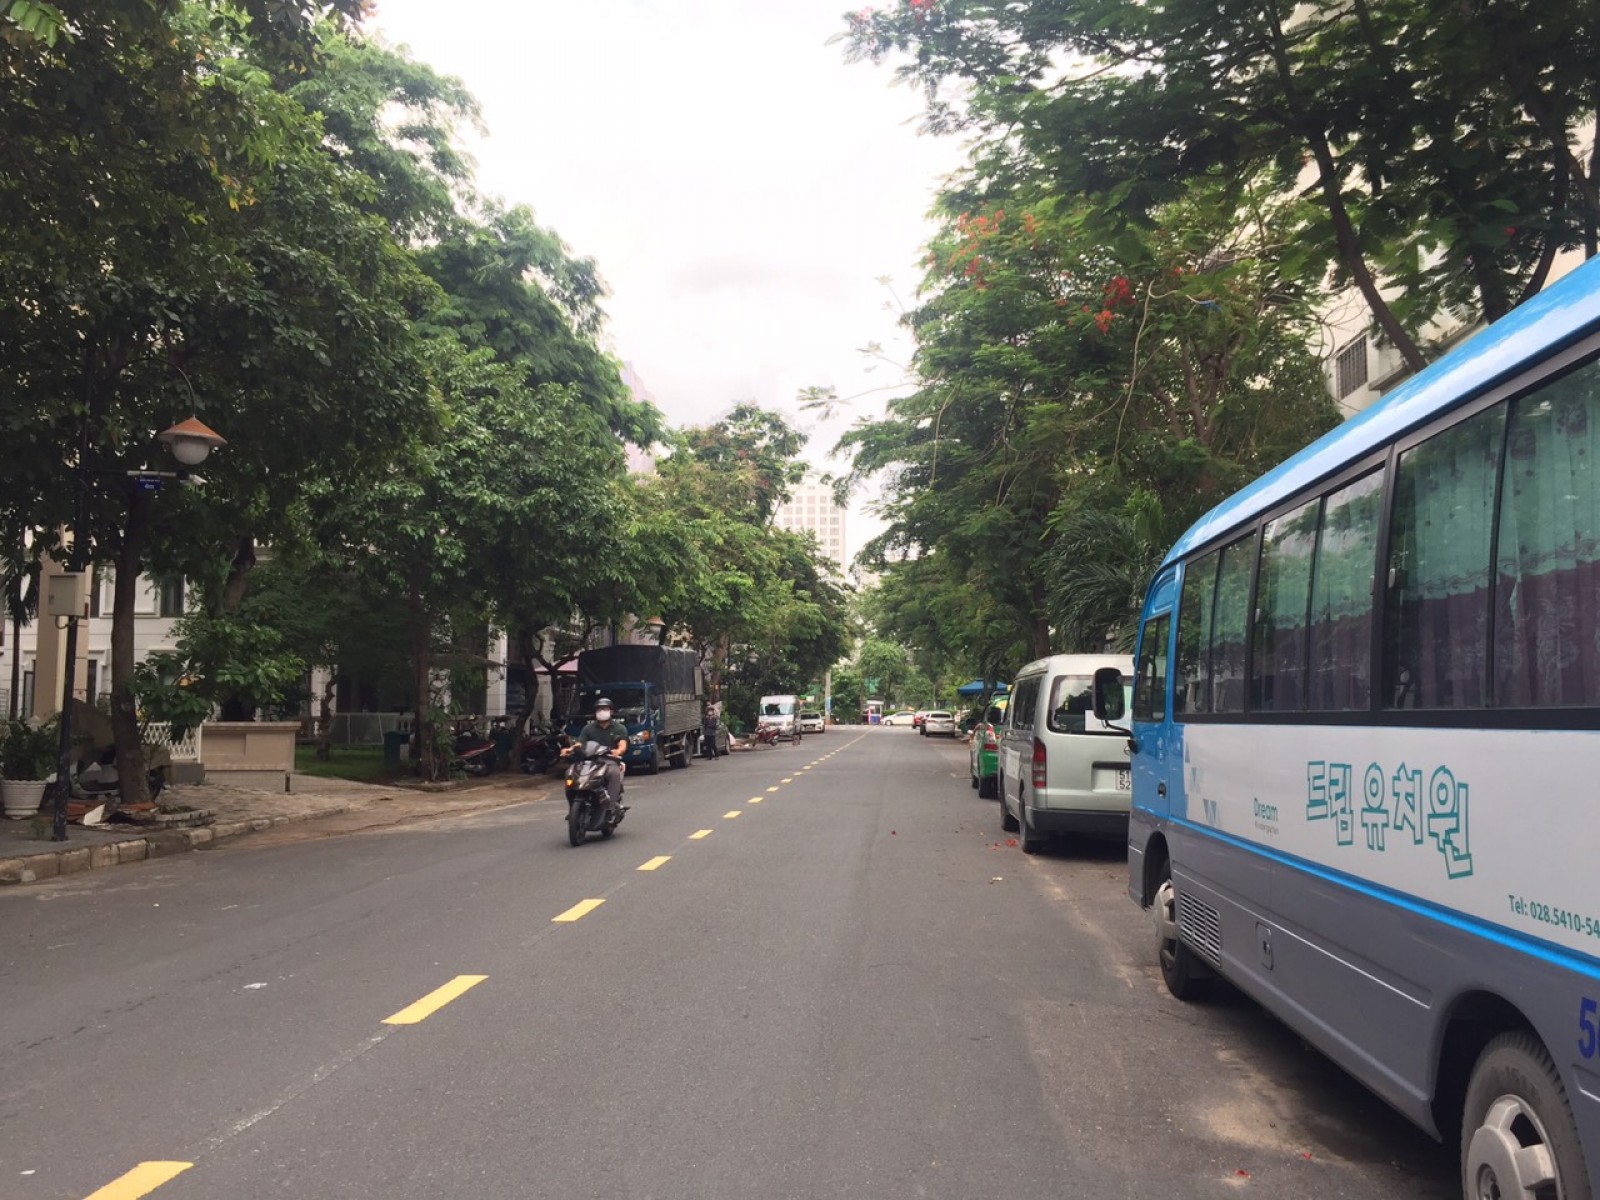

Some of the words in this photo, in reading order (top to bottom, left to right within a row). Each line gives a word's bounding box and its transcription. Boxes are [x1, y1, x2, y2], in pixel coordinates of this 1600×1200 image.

[1119, 780, 1131, 790] 52
[1253, 797, 1278, 822] Dream
[1508, 894, 1528, 916] Tel:
[1530, 901, 1600, 939] 028.5410-54
